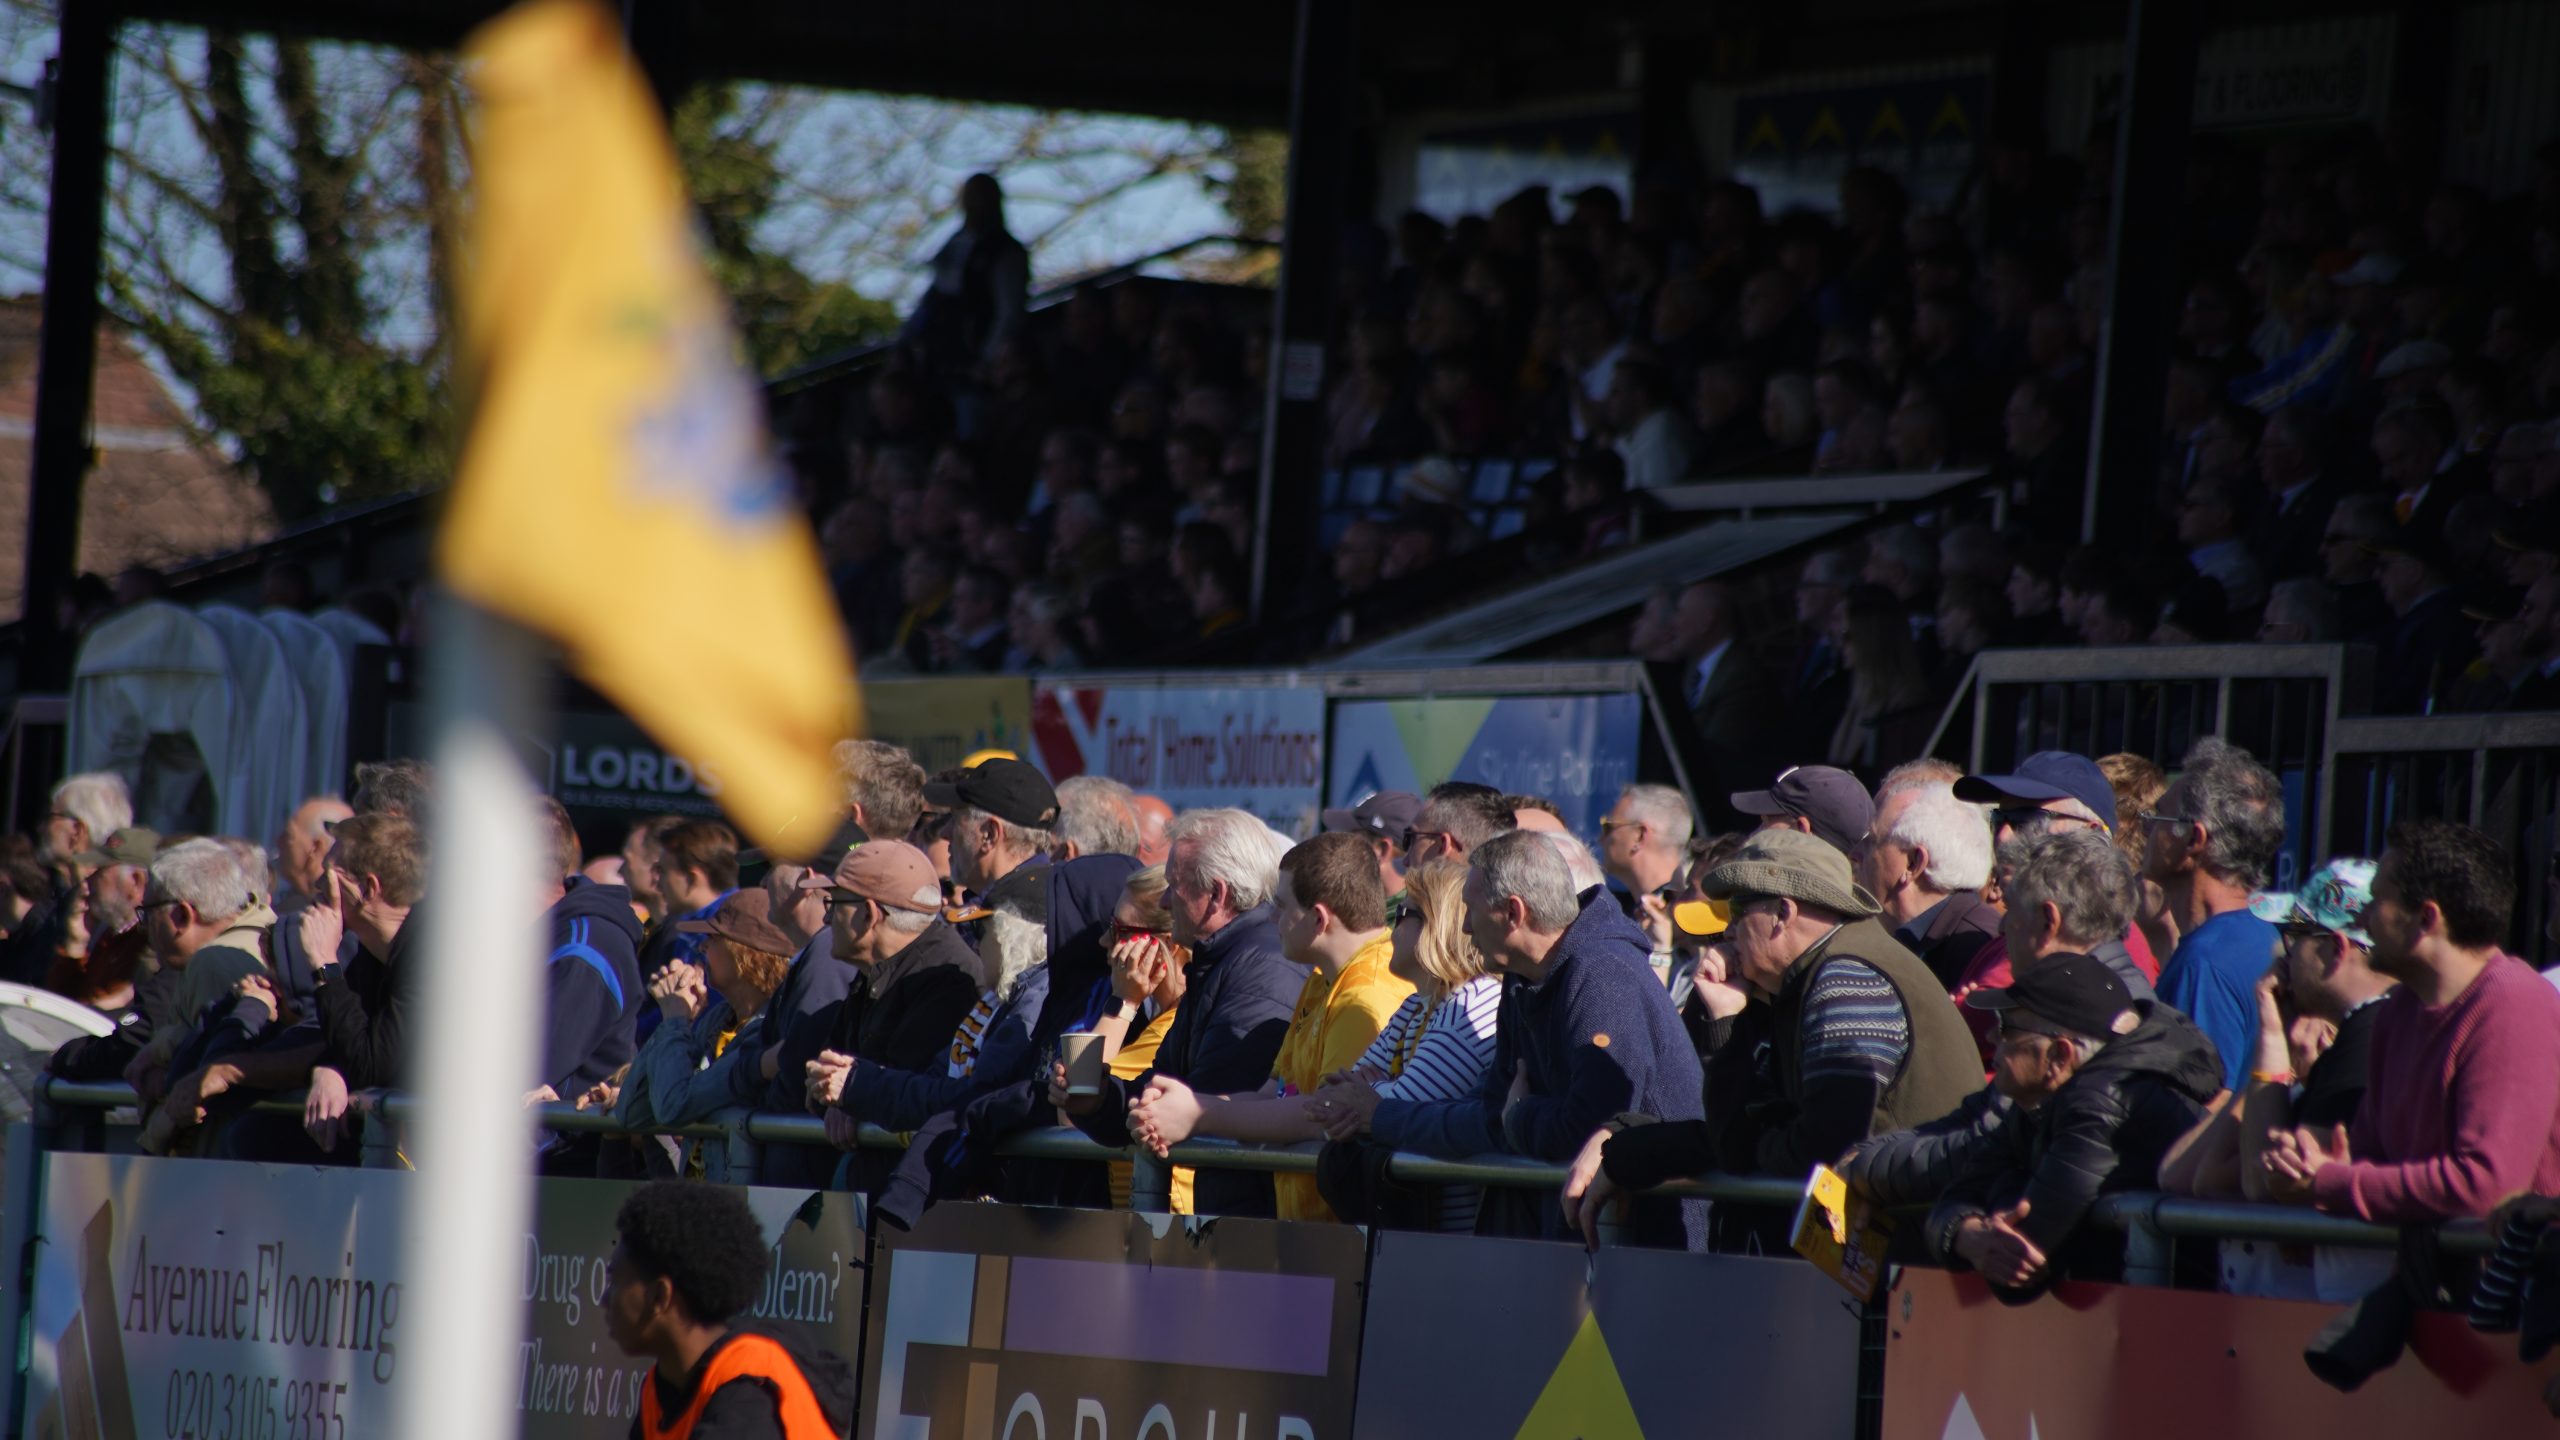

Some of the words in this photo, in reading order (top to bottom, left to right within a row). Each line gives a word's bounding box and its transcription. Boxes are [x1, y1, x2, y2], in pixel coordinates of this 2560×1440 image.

[562, 744, 725, 797] LORDS
[1106, 716, 1160, 787] Total
[1162, 716, 1217, 789] Home
[1219, 712, 1318, 788] Solutions
[520, 1232, 584, 1326] Drug
[166, 1369, 214, 1440] 020
[220, 1373, 279, 1440] 3105
[286, 1379, 348, 1440] 9355
[516, 1337, 579, 1415] There
[583, 1341, 603, 1417] is
[607, 1367, 623, 1418] a
